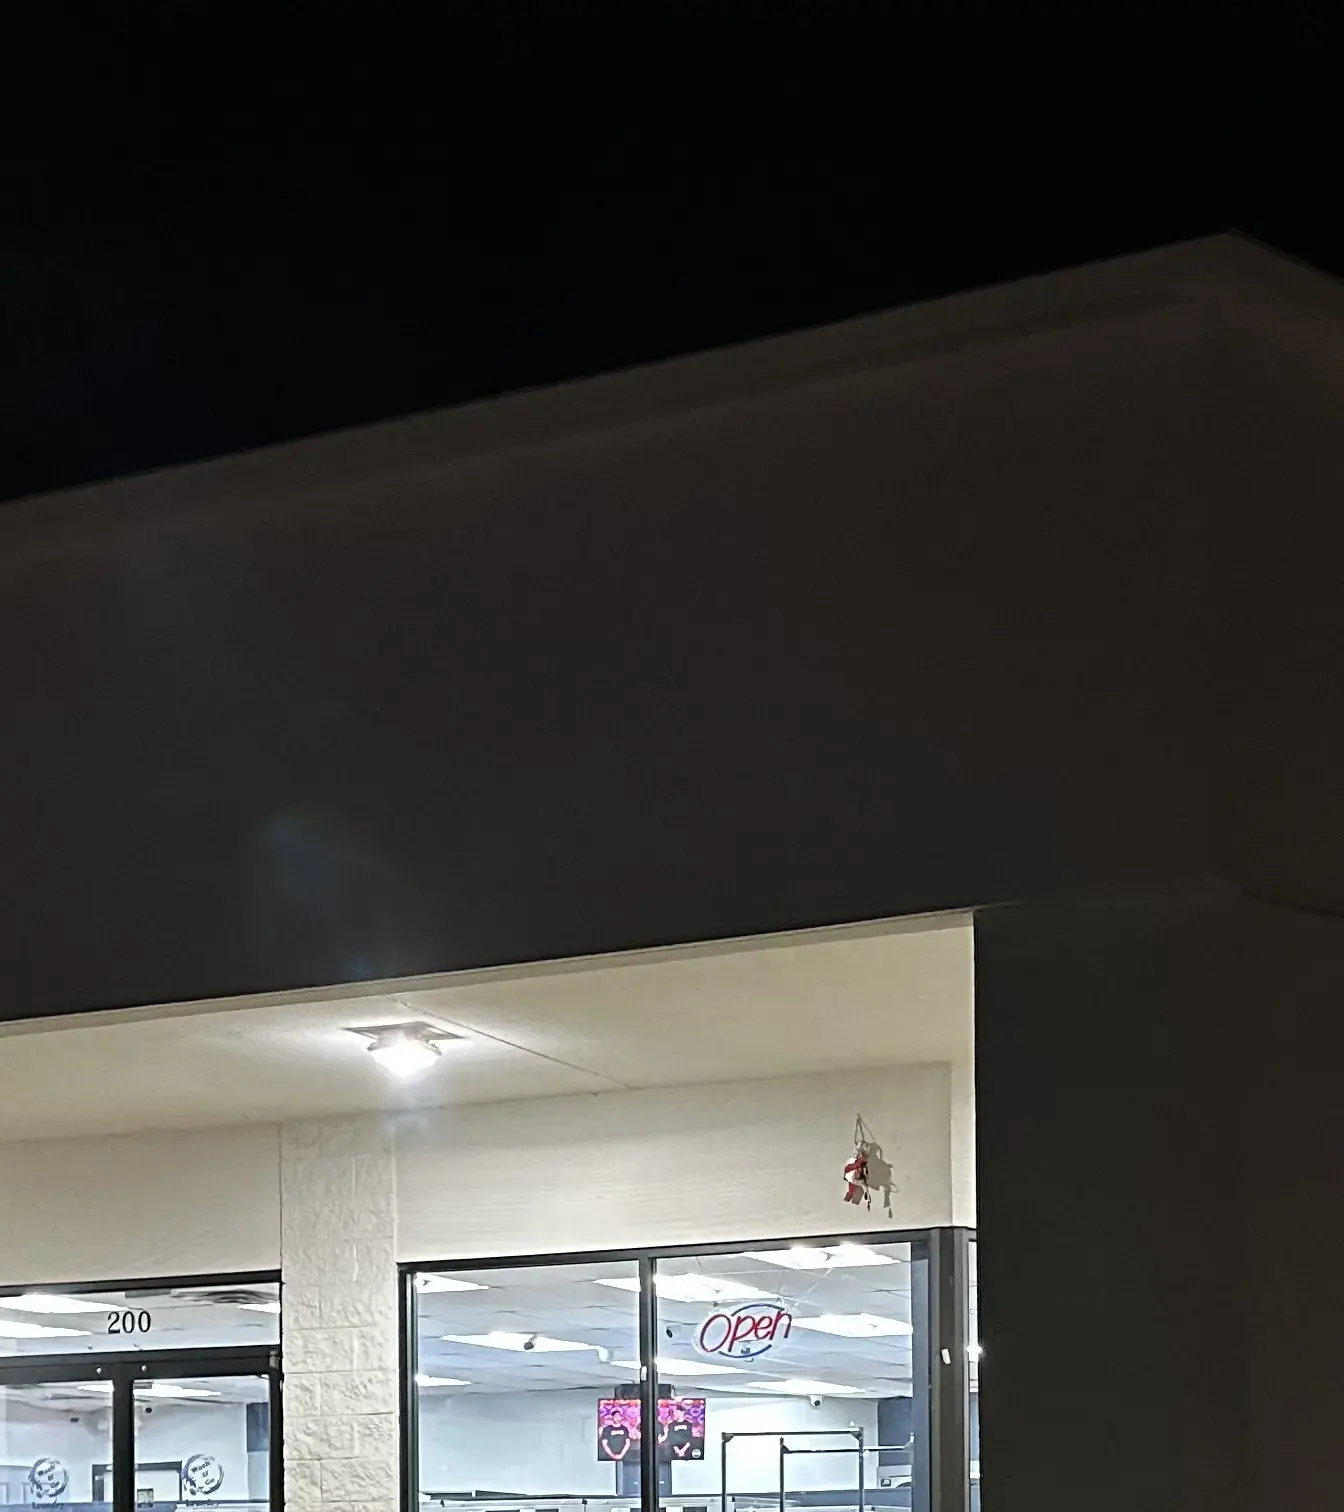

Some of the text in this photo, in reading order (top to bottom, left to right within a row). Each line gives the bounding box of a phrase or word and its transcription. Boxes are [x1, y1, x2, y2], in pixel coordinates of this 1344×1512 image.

[107, 1311, 151, 1334] 200
[700, 1310, 792, 1352] Open
[190, 1461, 210, 1473] Wash
